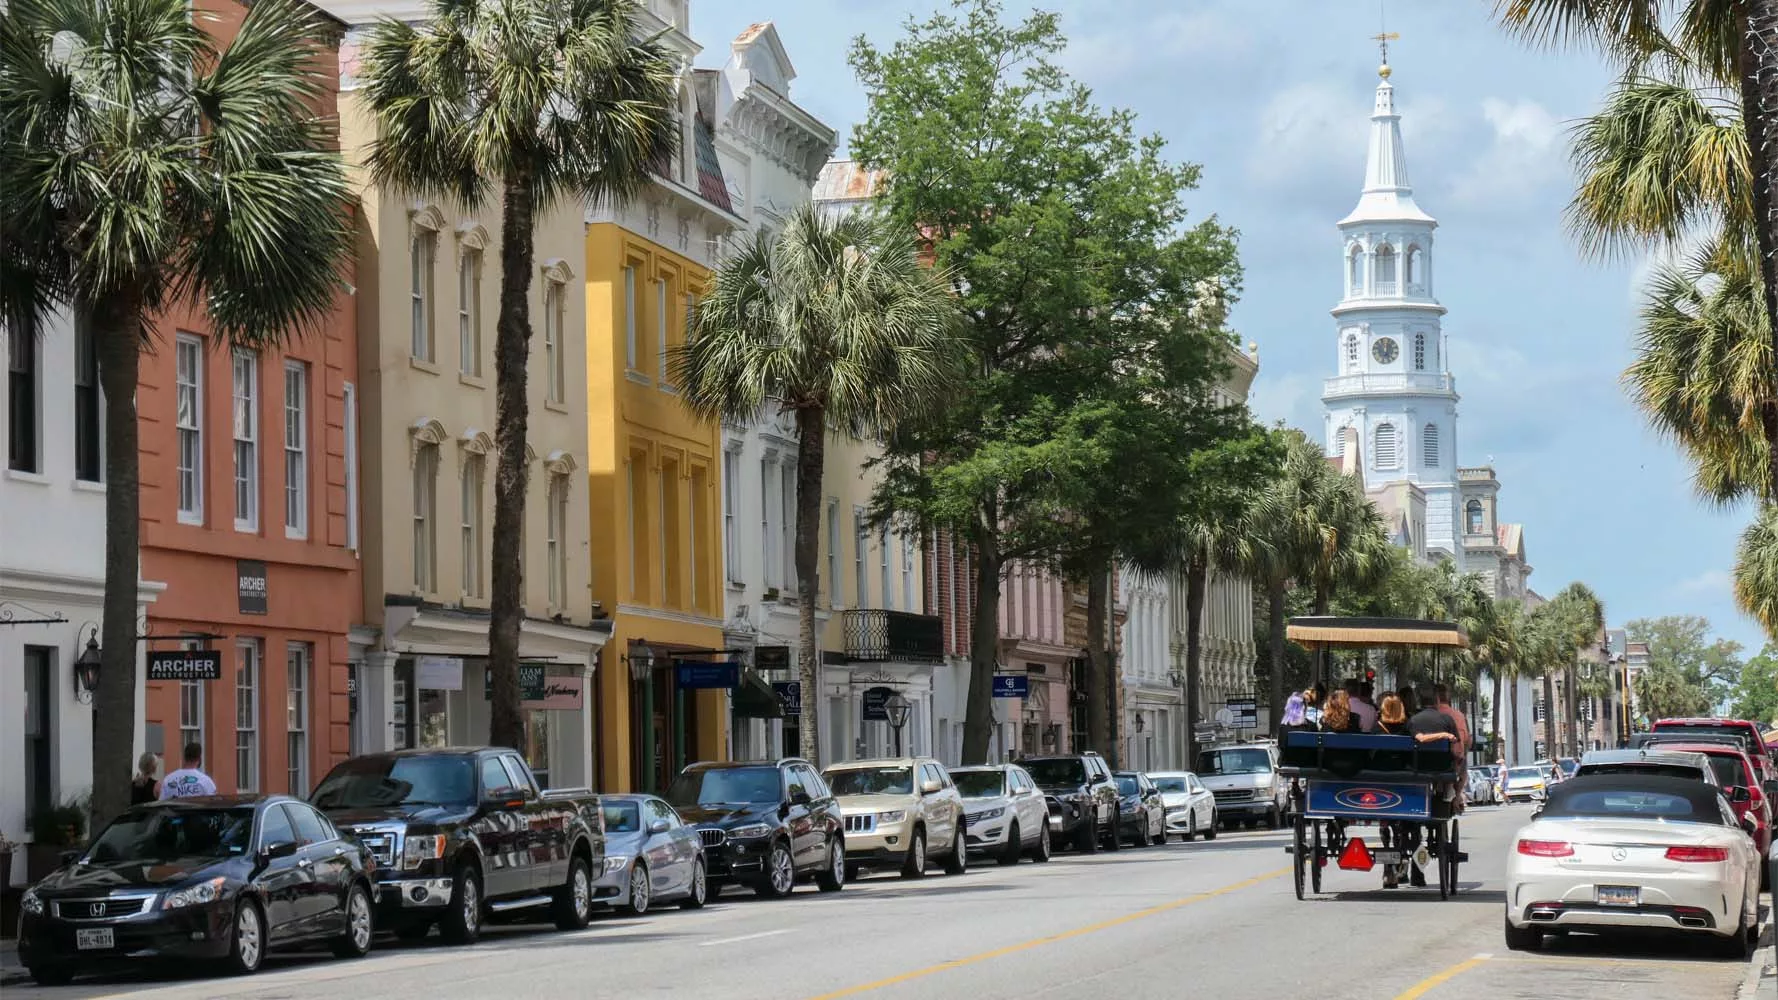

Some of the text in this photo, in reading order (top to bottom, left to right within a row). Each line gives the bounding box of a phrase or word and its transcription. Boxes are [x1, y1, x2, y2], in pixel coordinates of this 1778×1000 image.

[239, 576, 265, 590] ARCHER
[151, 660, 214, 672] ARCHER
[177, 784, 199, 797] NIKE
